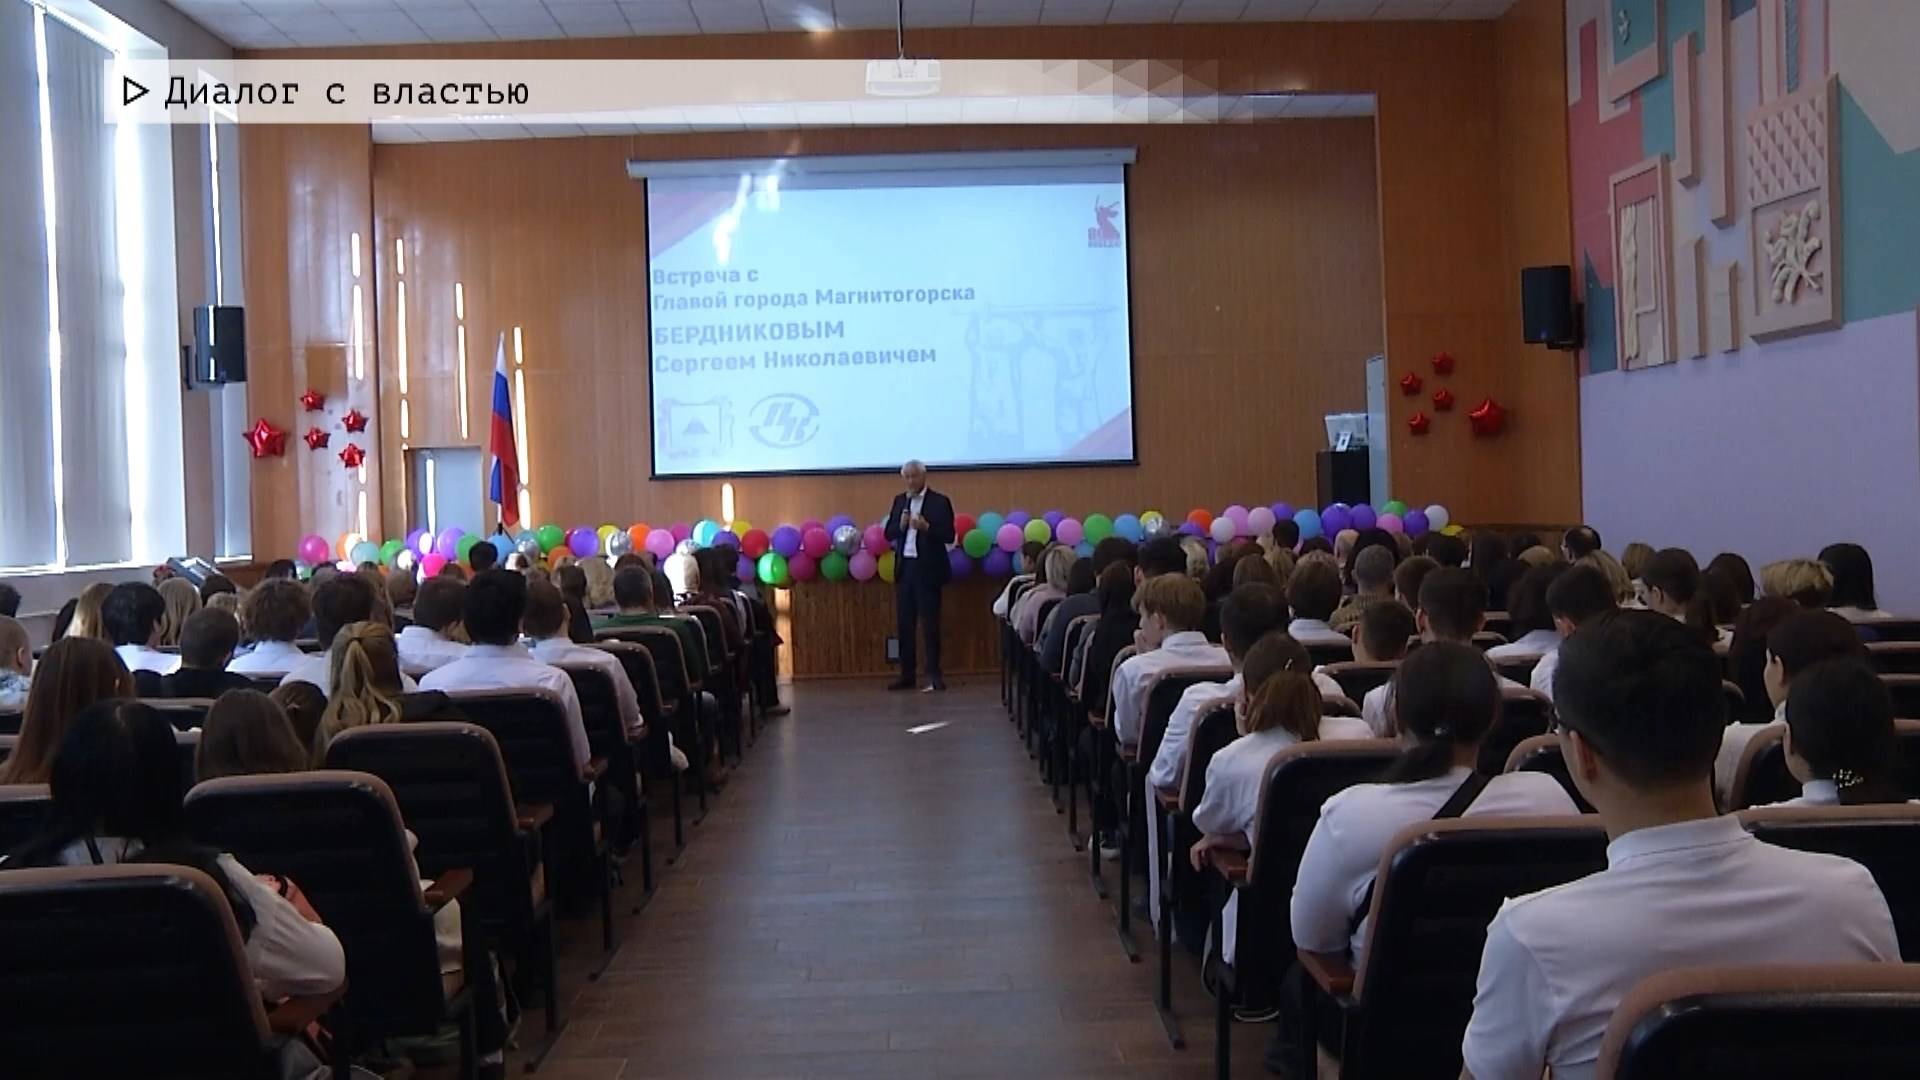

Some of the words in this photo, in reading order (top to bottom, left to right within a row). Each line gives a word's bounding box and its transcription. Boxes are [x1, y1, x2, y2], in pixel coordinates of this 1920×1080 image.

[653, 269, 741, 287] Встреча
[747, 269, 760, 282] с
[653, 291, 728, 311] Главой
[734, 291, 808, 310] города
[815, 287, 976, 305] Магнитогорска
[655, 320, 845, 345] БЕРДНИКОВЫМ
[655, 353, 756, 375] Сергеем
[764, 349, 937, 369] Николаевичем
